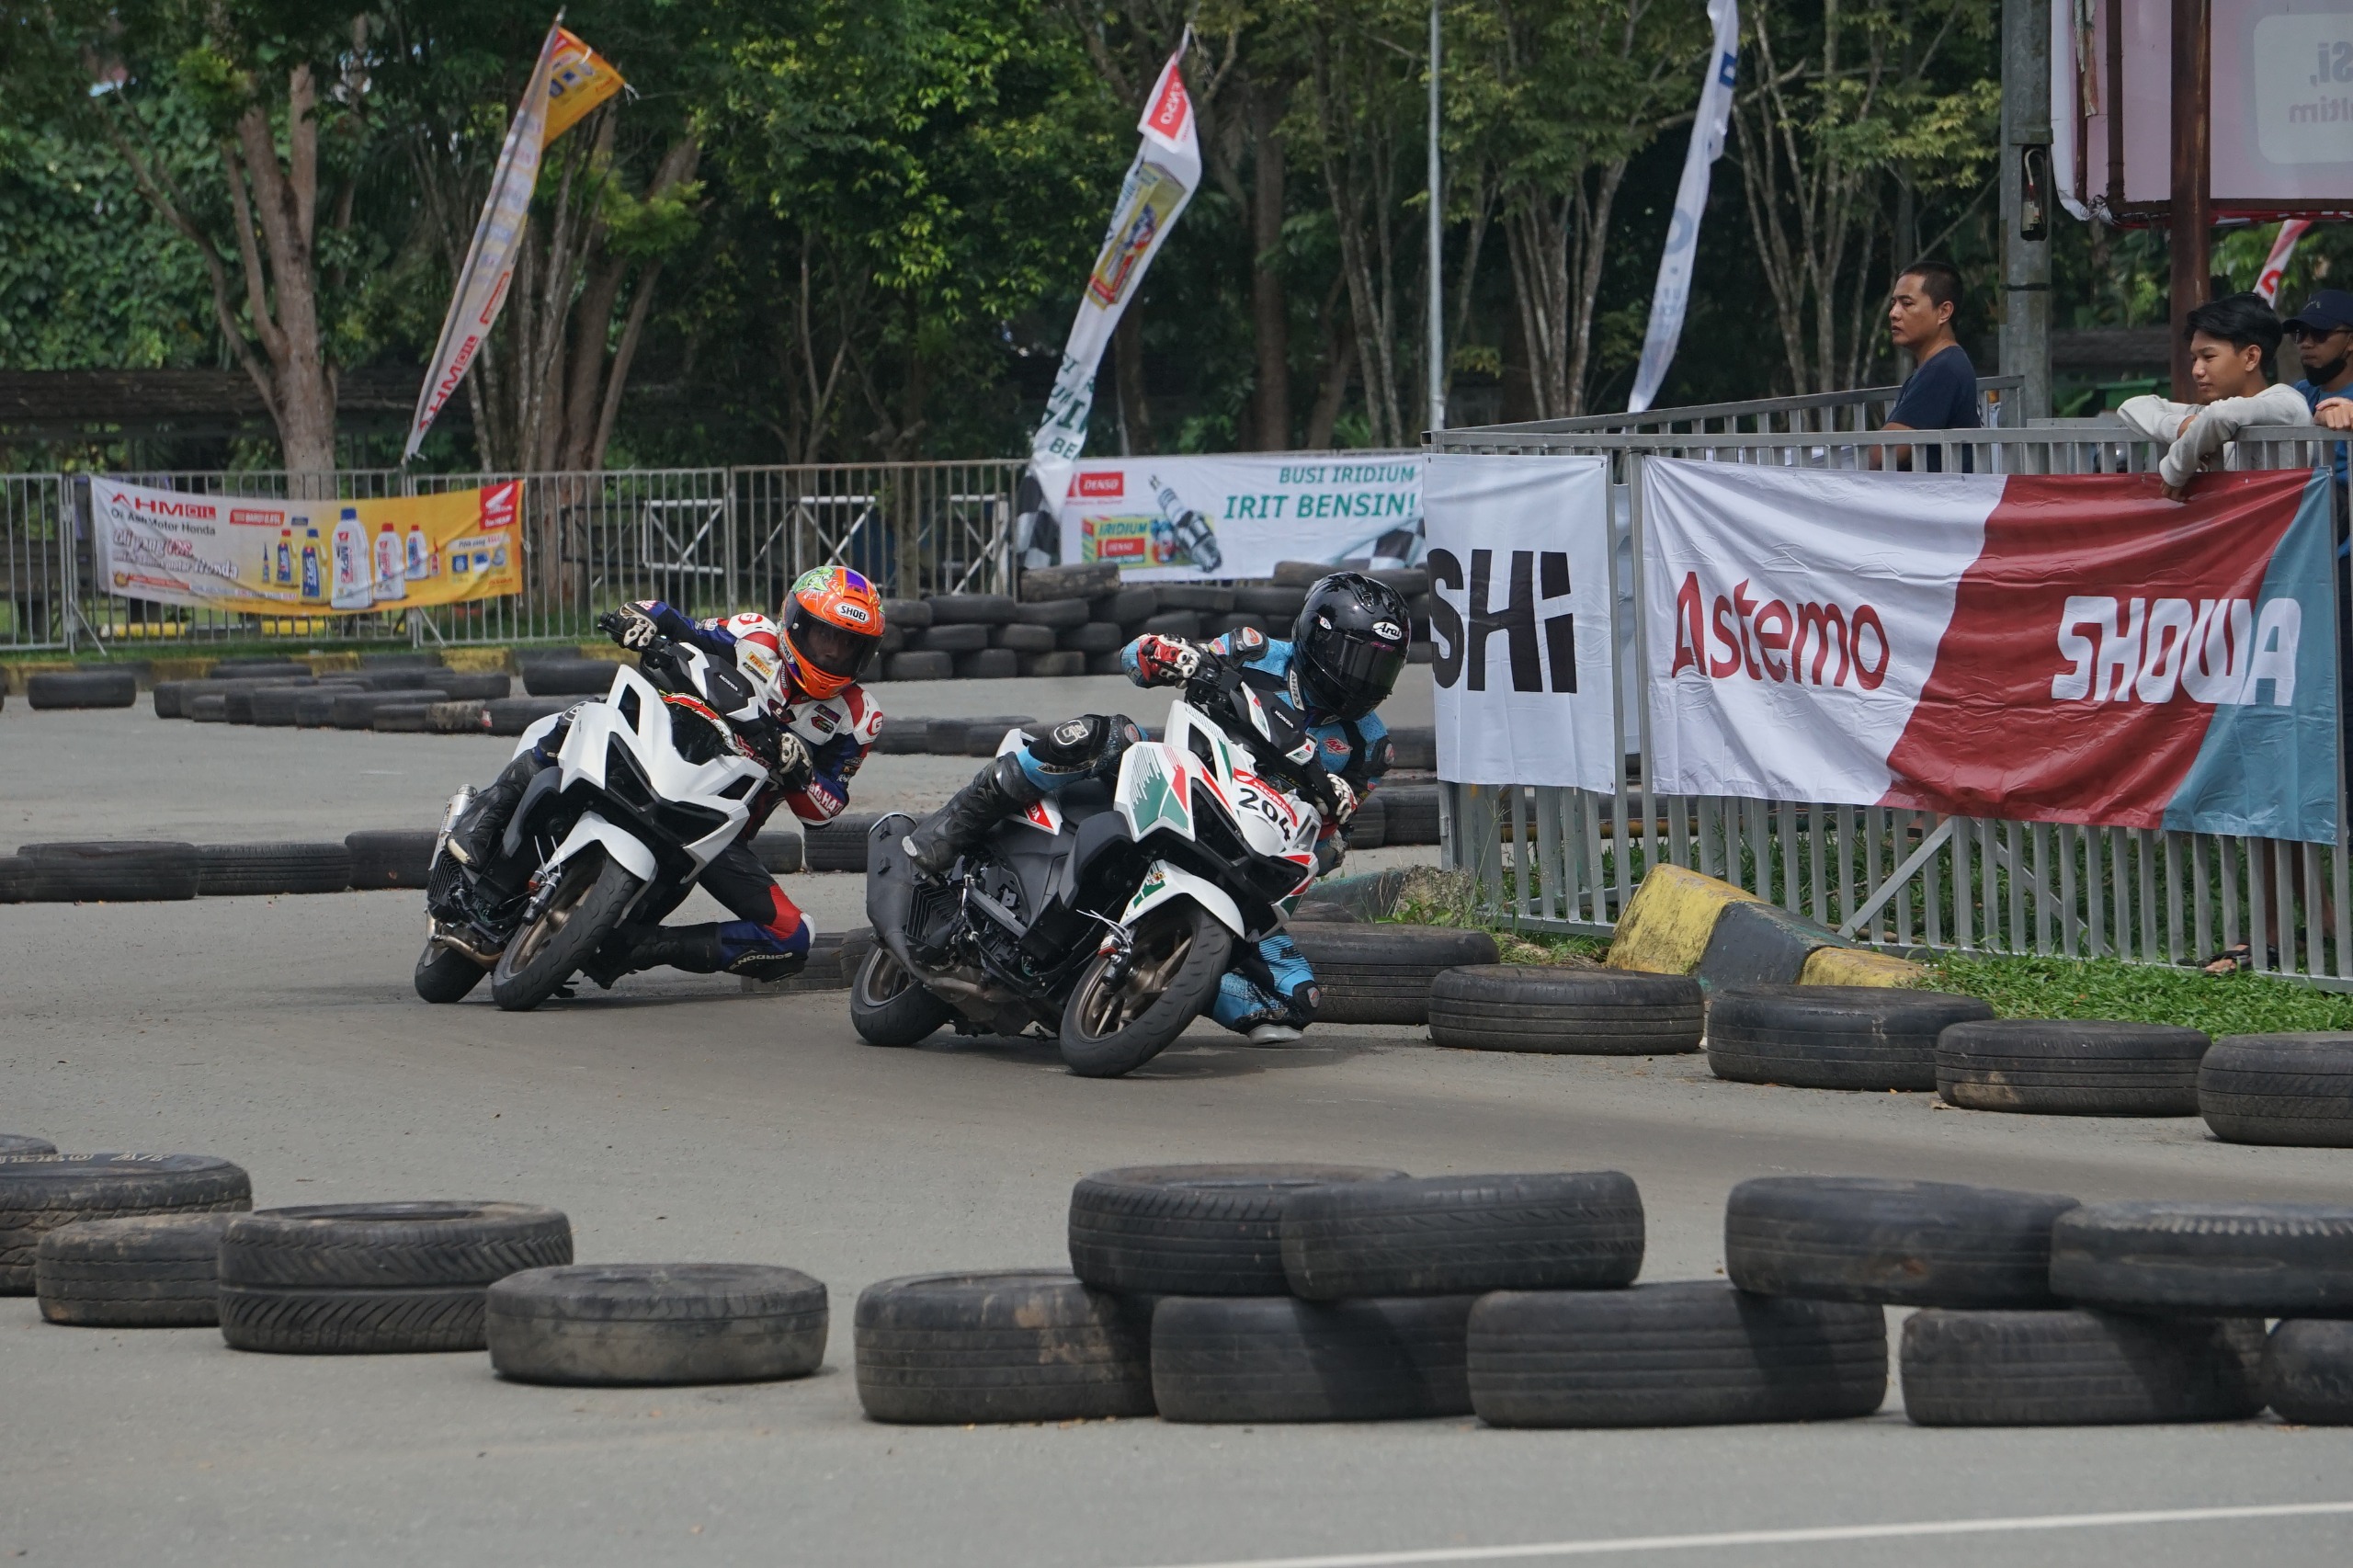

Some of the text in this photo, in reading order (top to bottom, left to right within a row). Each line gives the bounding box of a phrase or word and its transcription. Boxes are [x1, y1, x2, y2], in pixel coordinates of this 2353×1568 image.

[1279, 465, 1415, 483] BUSI IRIDIUM
[1083, 478, 1120, 491] DENSO
[1223, 492, 1416, 519] IRIT BENSIN!
[181, 521, 217, 537] Honda
[1098, 522, 1148, 536] IRIDIUM
[840, 605, 867, 622] SHOEI
[1374, 622, 1401, 637] Arai
[1671, 570, 1891, 691] Astemo
[2051, 595, 2302, 707] SHOWA
[719, 674, 739, 693] HONDA
[1274, 710, 1294, 729] HONDA
[1238, 788, 1290, 842] 204
